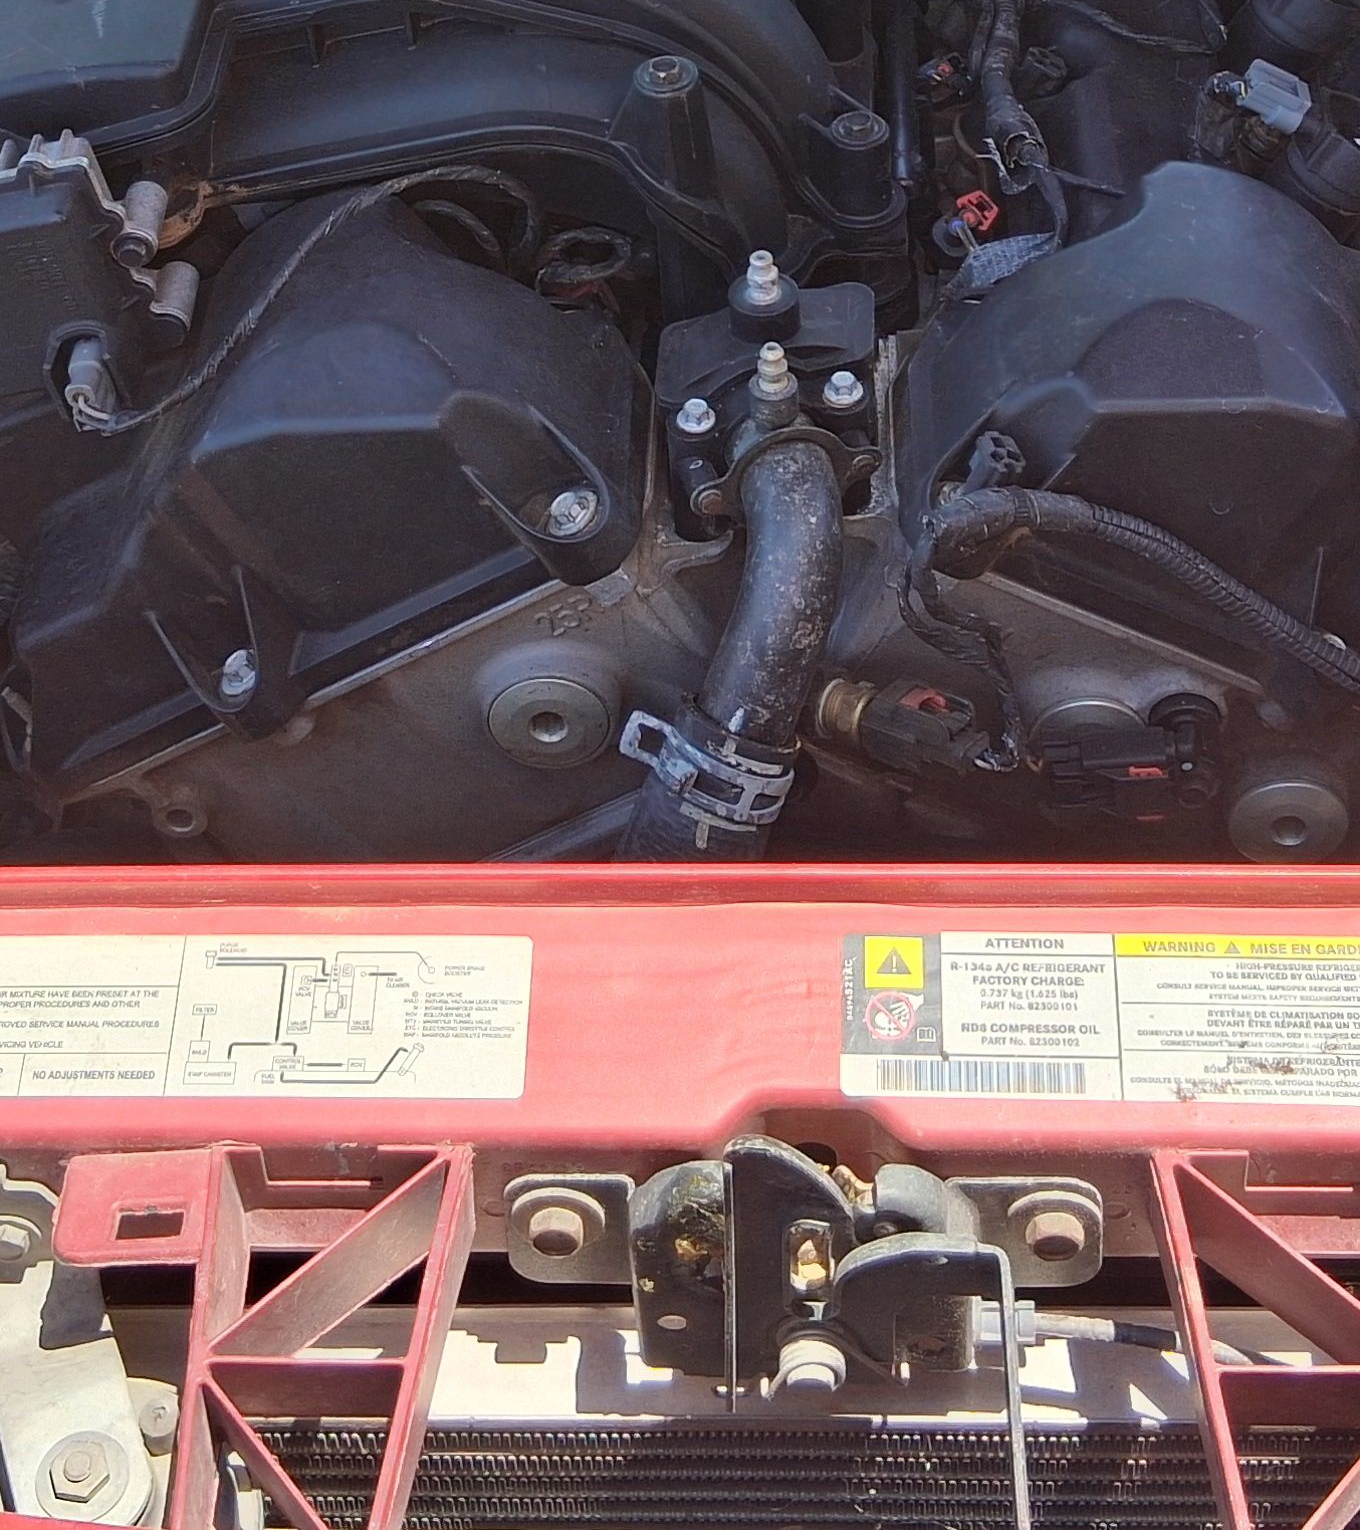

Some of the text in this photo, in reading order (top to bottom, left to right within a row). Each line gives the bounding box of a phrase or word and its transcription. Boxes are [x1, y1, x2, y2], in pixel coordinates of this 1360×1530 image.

[984, 937, 1064, 949] ATTENTION
[1142, 940, 1216, 953] WARNING
[1249, 942, 1287, 954] MISE
[1290, 943, 1311, 955] EN
[994, 962, 1019, 974] A/C
[1022, 962, 1106, 973] REFRIGERANT
[972, 975, 1085, 986] FACTORY CHARGE:
[1209, 971, 1224, 979] TO
[1225, 971, 1239, 979] BE
[1240, 971, 1288, 980] SERVICED
[1290, 972, 1303, 980] BY
[1304, 972, 1357, 981] QUALIFIED
[989, 1023, 1076, 1034] COMPRESSOR
[1078, 1024, 1100, 1035] OIL
[32, 1070, 155, 1080] NO ADJUSTMENTS NEEDED
